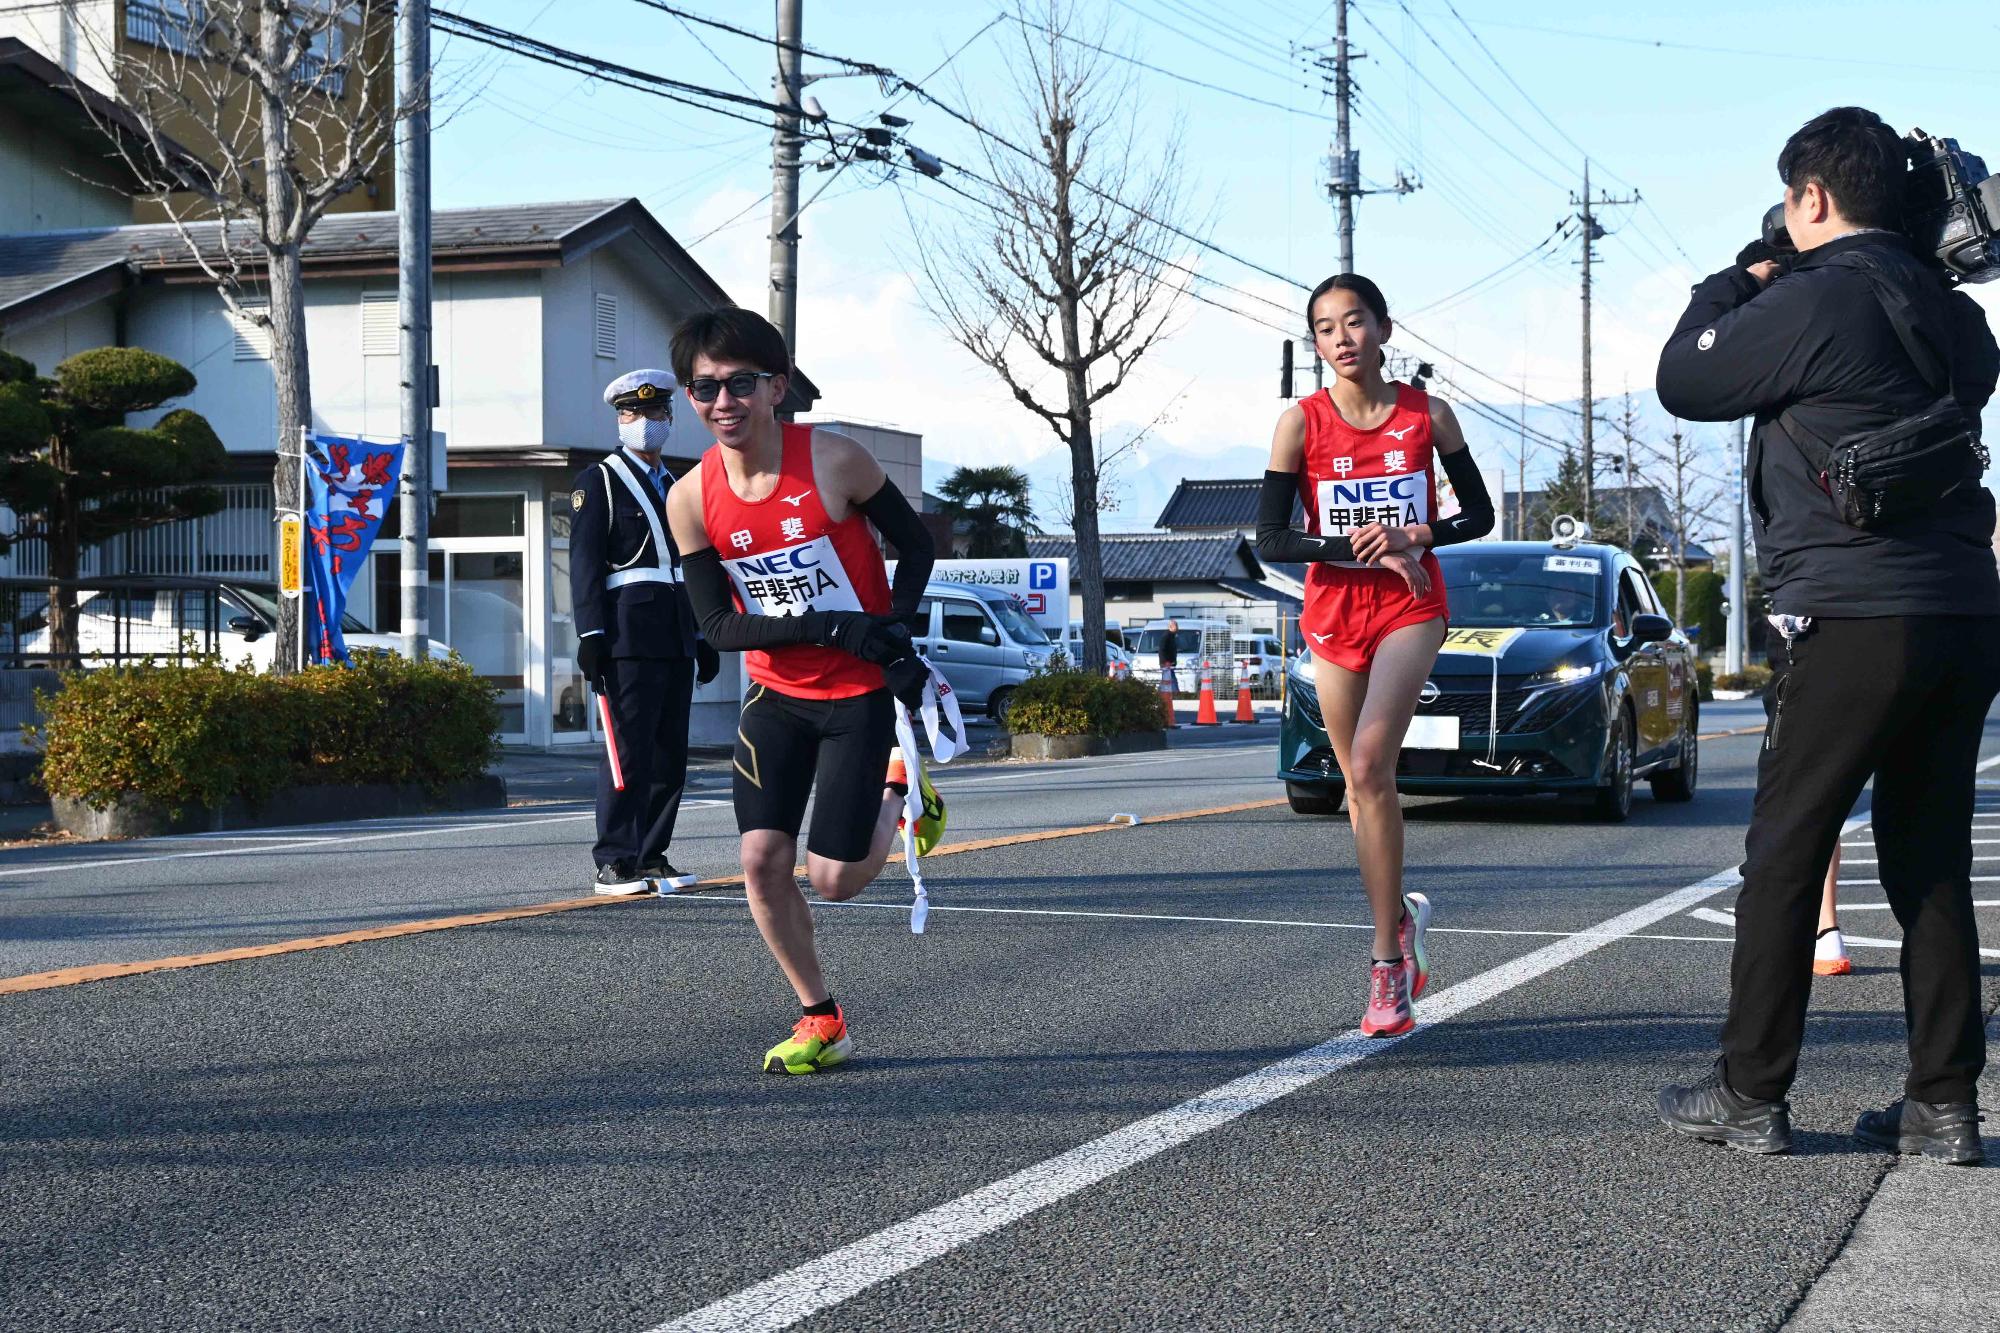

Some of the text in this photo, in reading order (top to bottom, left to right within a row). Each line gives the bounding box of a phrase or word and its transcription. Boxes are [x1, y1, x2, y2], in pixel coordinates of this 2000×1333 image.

[1333, 450, 1407, 478] 甲 斐
[1333, 477, 1415, 504] NEC
[730, 517, 806, 551] 甲 斐
[737, 545, 821, 577] NEC
[744, 567, 839, 607] 甲斐市A
[934, 569, 1020, 584] 処方せん受付
[1036, 565, 1053, 588] P
